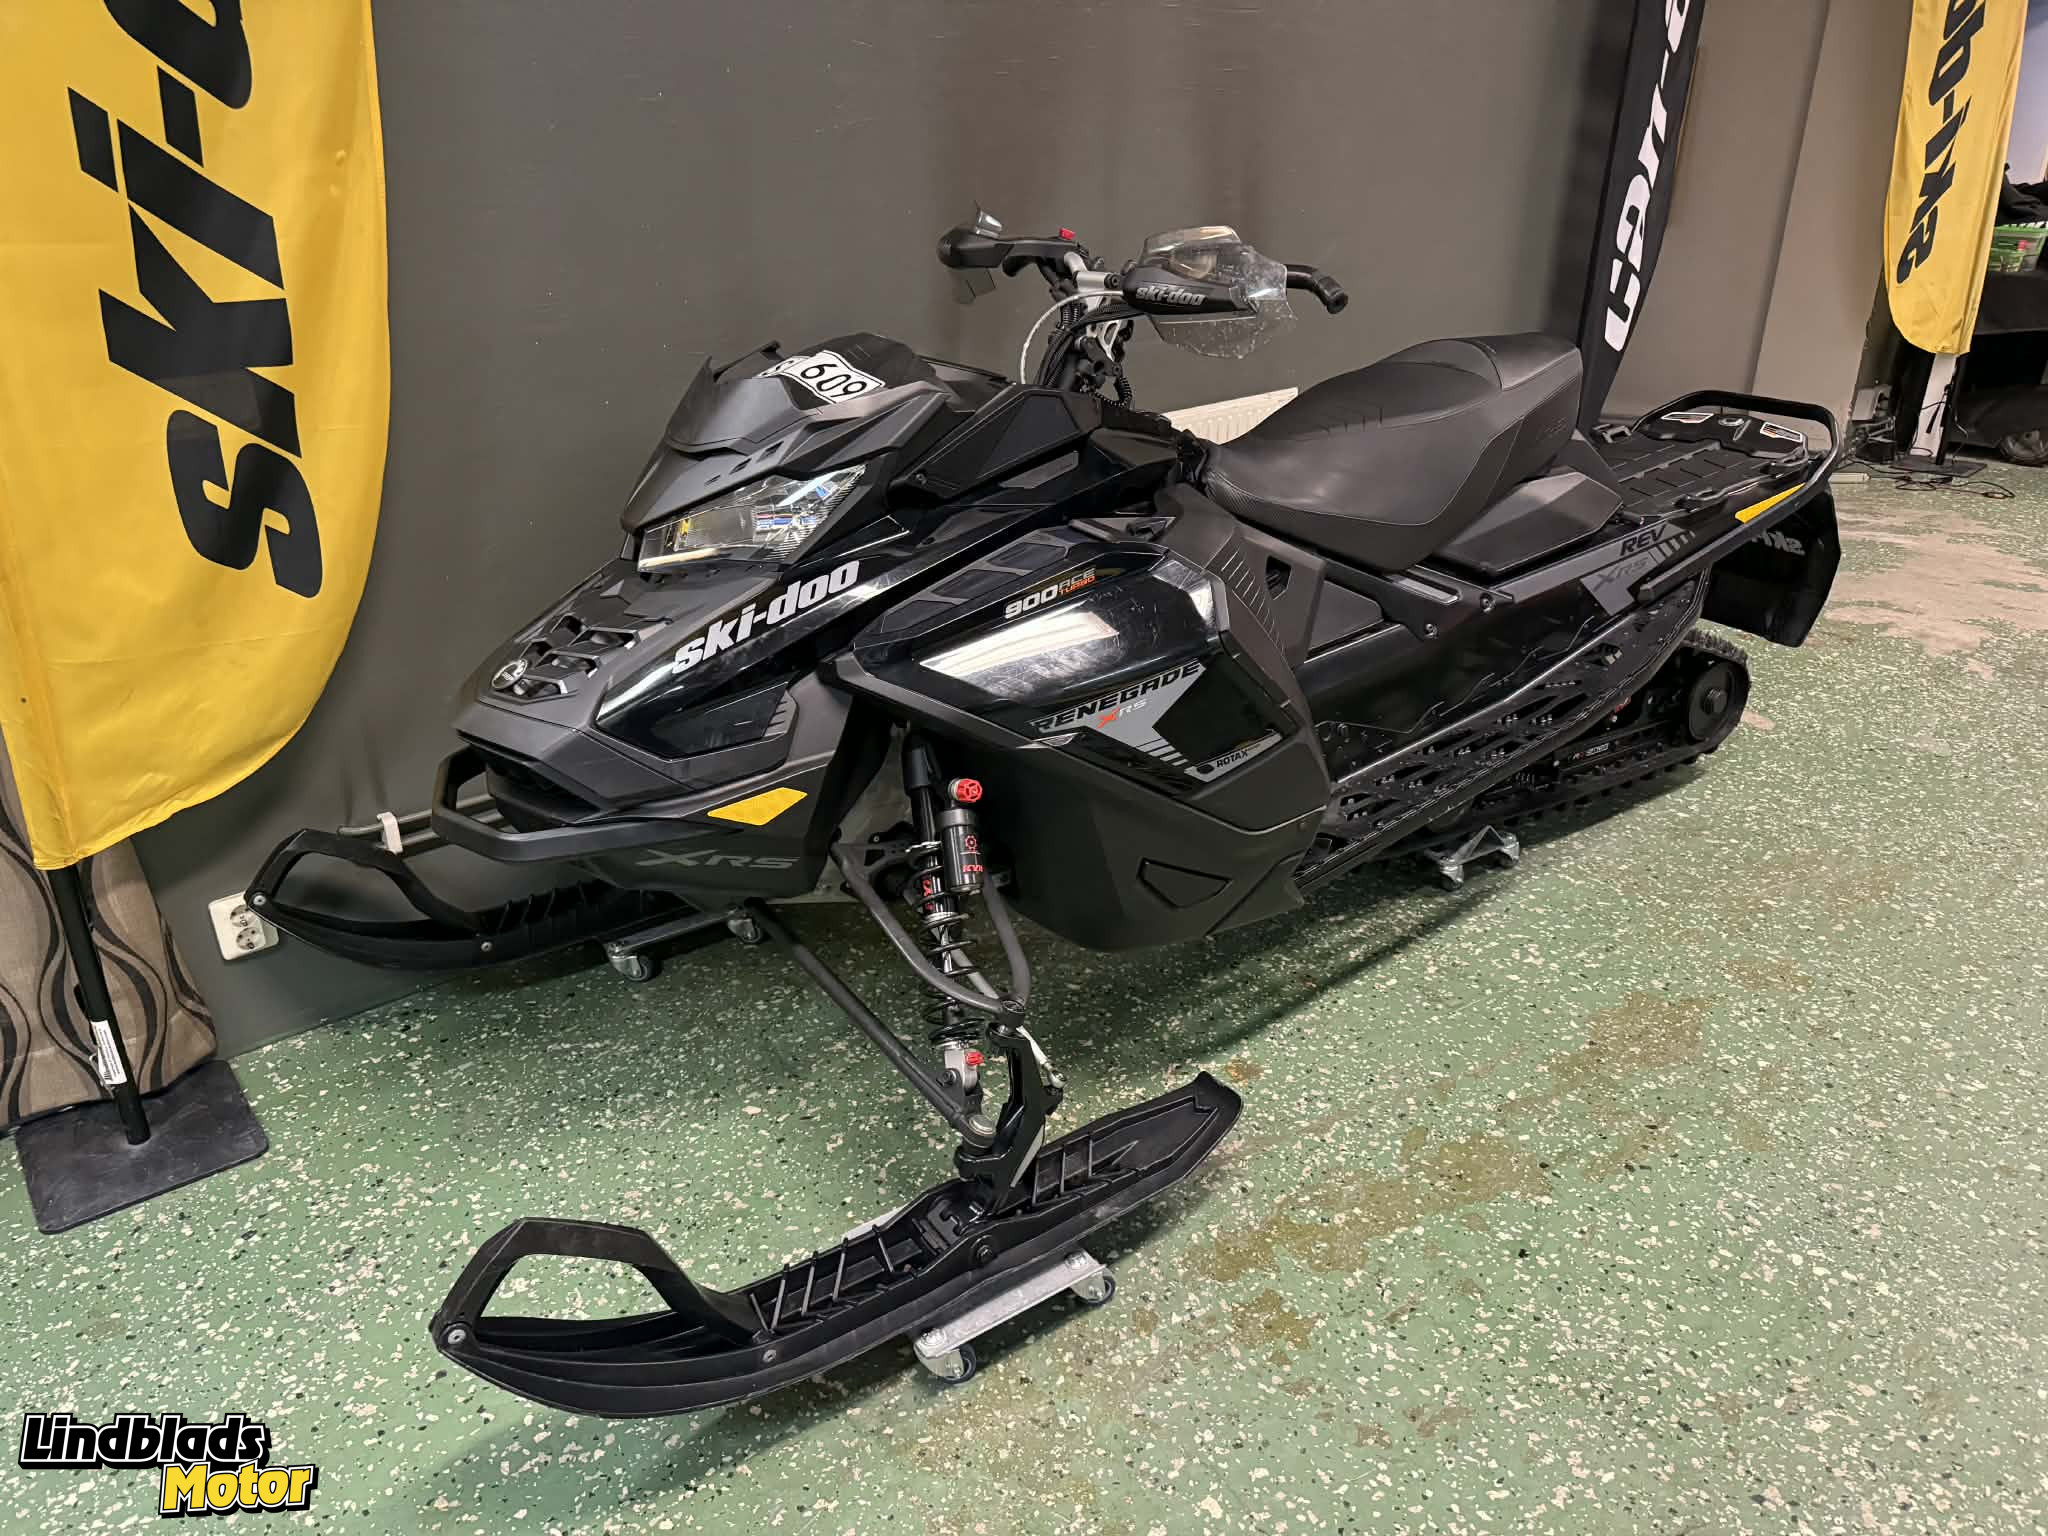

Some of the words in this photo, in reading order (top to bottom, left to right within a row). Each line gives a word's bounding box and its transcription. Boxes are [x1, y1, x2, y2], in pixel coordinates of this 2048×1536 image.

[1135, 284, 1208, 307] ski-doo
[800, 363, 868, 398] 609
[1620, 524, 1667, 556] REV
[671, 560, 860, 675] ski-doo
[1004, 584, 1059, 619] 900
[1031, 660, 1203, 732] RENEGADE
[1097, 700, 1148, 729] XRS
[1216, 749, 1249, 768] ROTAX
[634, 848, 801, 870] XRS
